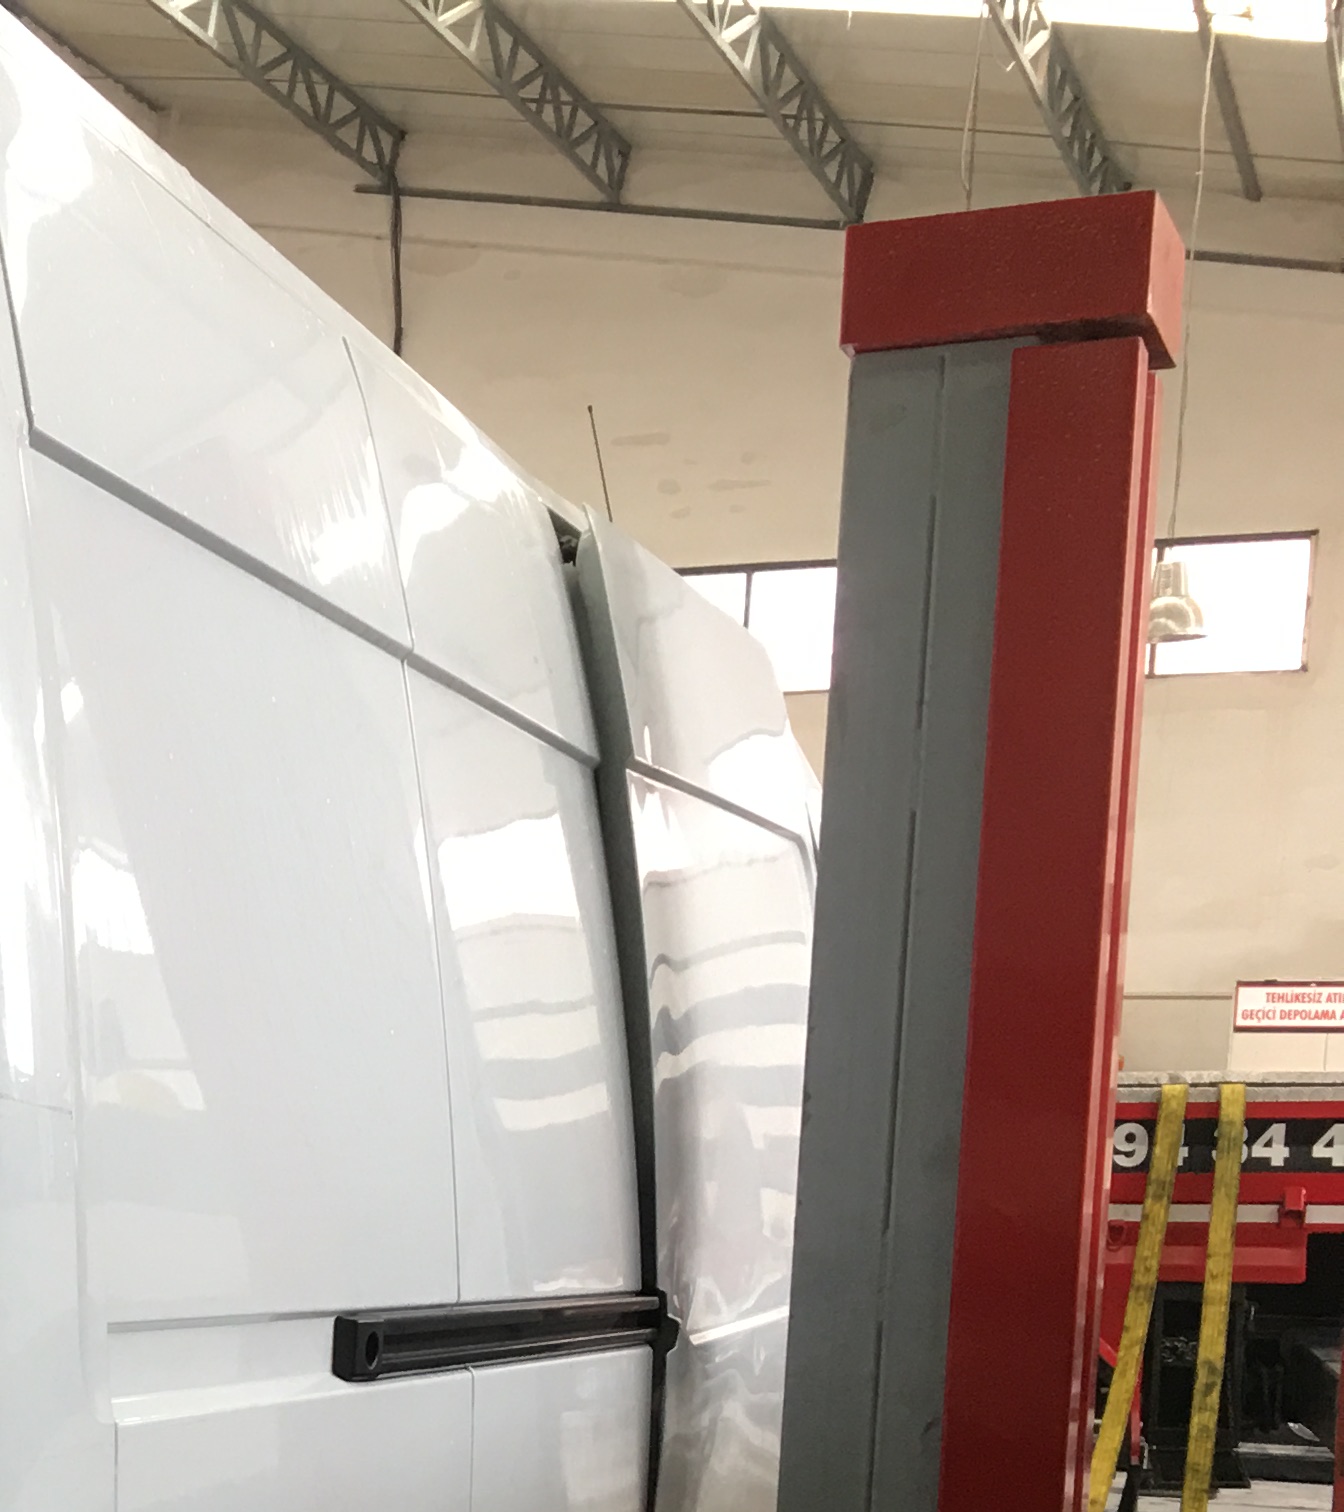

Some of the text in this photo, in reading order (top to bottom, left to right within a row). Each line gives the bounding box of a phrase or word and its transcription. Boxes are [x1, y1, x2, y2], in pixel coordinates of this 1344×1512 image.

[1265, 990, 1344, 1004] TEHLİKESİZ ATI
[1241, 1006, 1276, 1023] GEÇİCİ
[1279, 1009, 1337, 1021] DEPOLAMA
